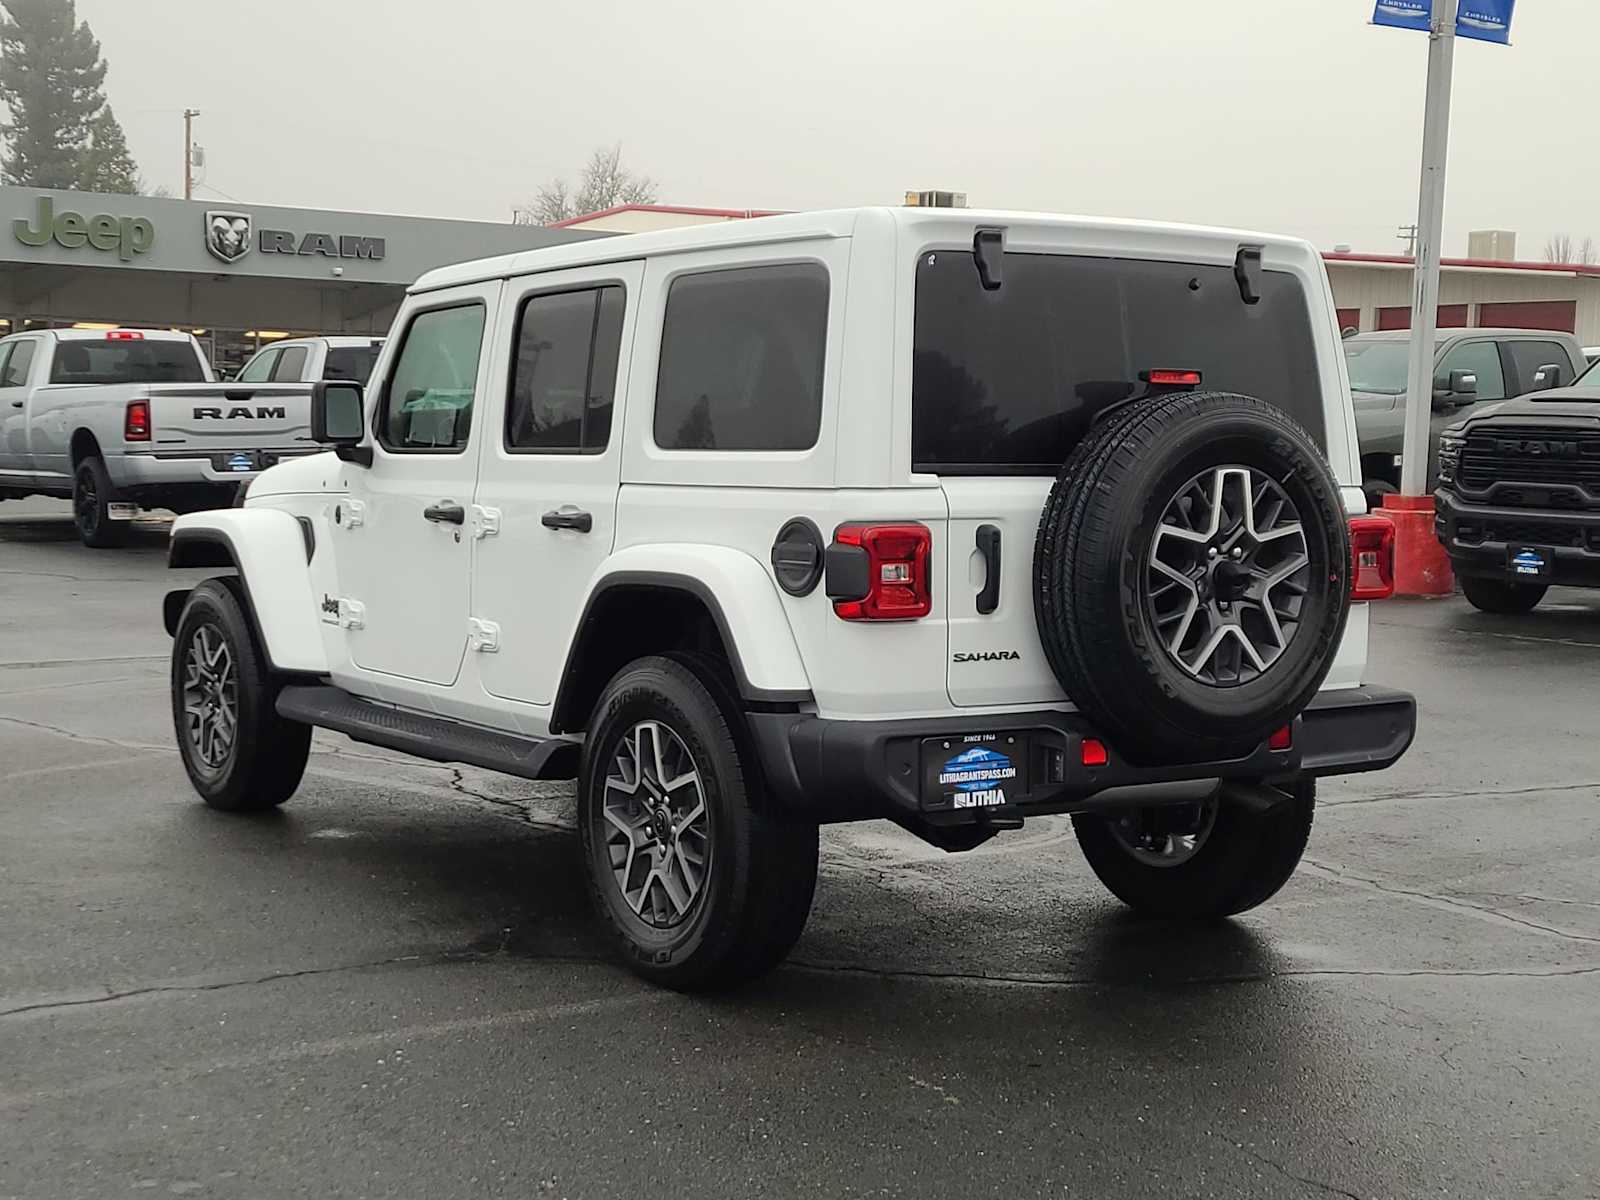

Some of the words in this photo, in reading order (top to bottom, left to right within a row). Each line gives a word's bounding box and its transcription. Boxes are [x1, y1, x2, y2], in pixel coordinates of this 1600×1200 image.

[1464, 11, 1501, 23] CHRYSLER
[12, 196, 155, 261] Jeep
[259, 229, 387, 260] RAM
[193, 407, 286, 419] RAM
[953, 650, 1021, 663] SAHARA
[963, 734, 981, 743] SINCE
[939, 767, 1016, 784] LITHIAGRANTSPASS.COM
[966, 789, 1006, 808] LITHIA
